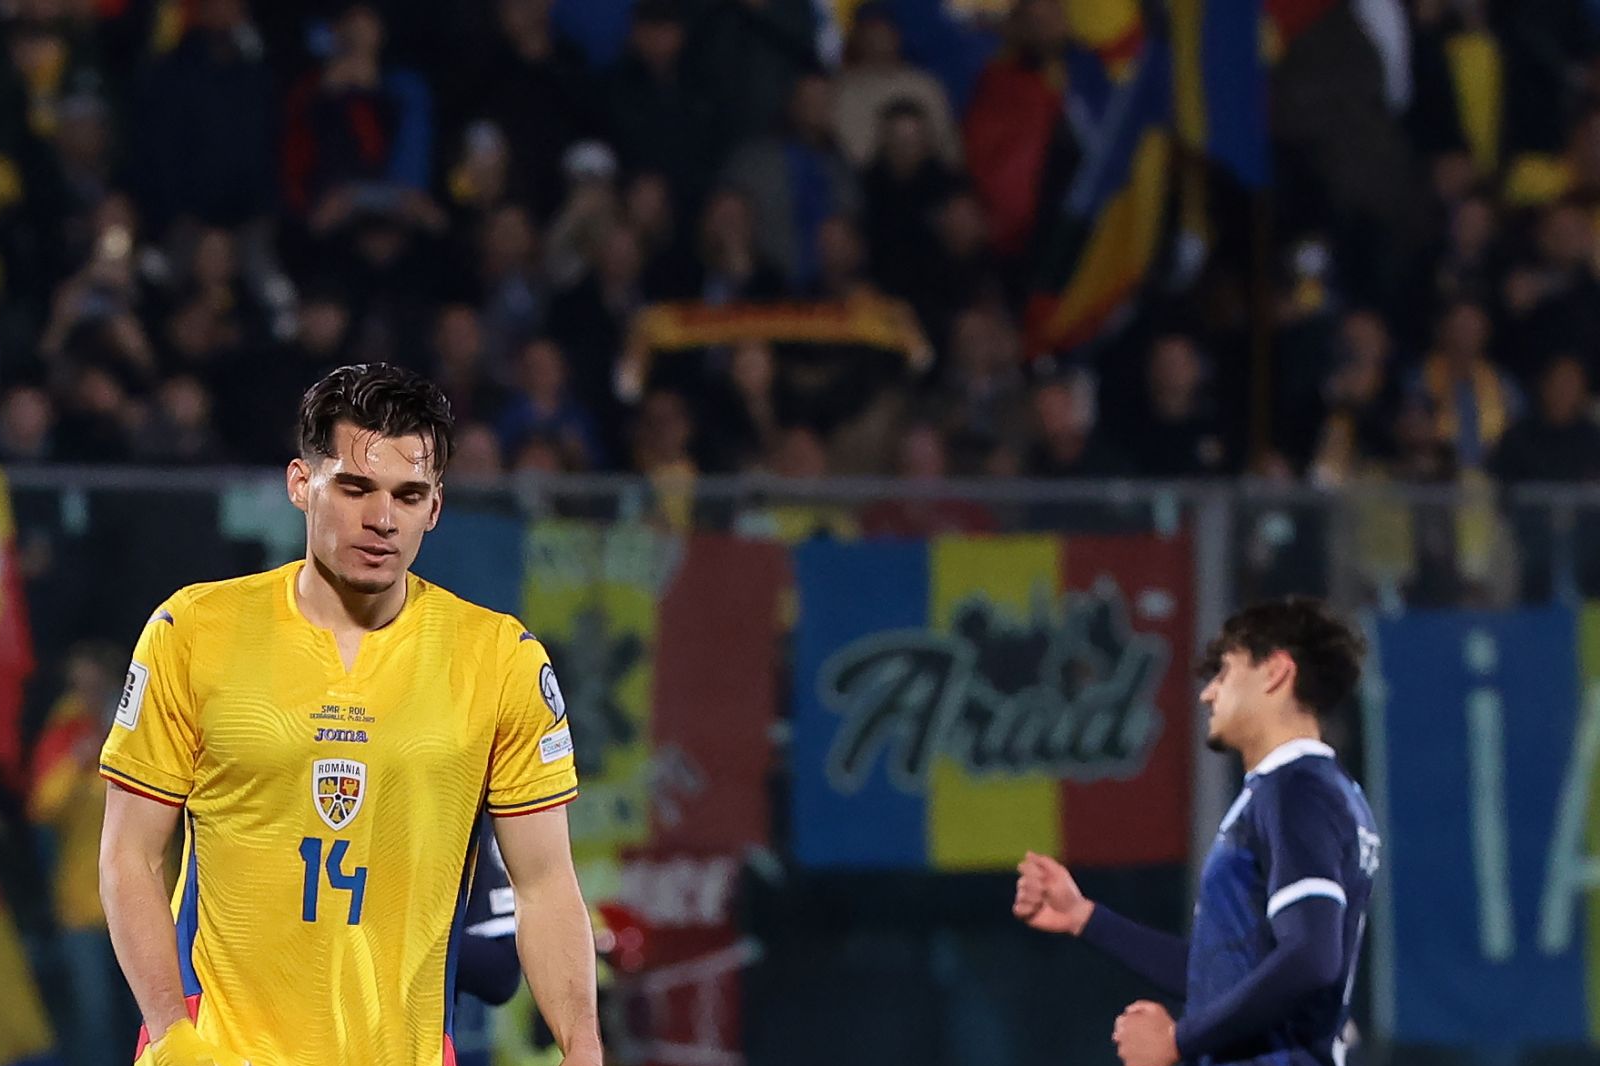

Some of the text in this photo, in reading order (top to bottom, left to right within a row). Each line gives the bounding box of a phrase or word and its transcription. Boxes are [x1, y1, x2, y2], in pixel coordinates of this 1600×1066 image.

[321, 705, 340, 713] SMR
[349, 707, 366, 715] ROU
[318, 761, 361, 776] ROMÂNIA
[299, 837, 367, 925] 14
